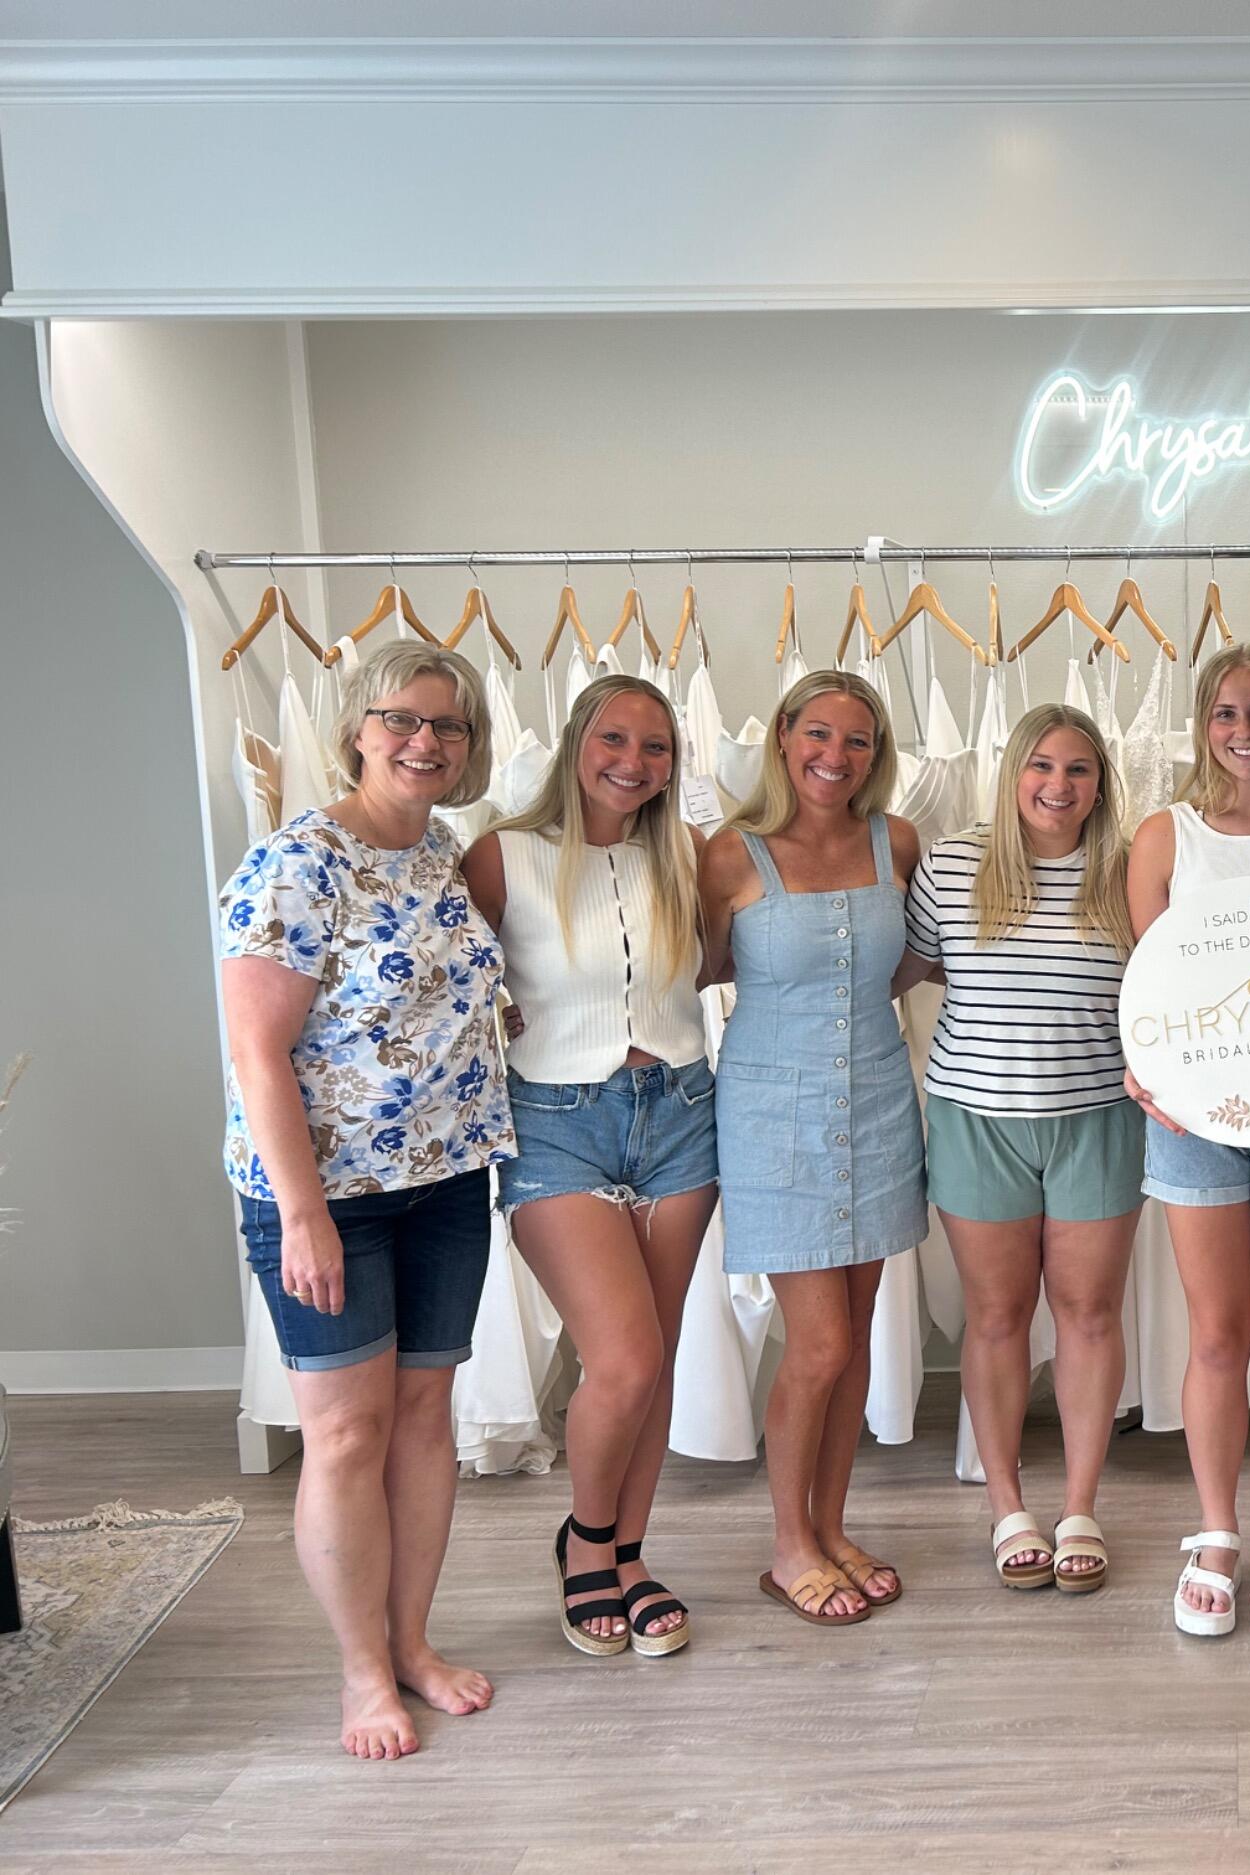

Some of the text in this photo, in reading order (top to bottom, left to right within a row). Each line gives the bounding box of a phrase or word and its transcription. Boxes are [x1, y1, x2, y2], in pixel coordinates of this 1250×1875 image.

[1213, 910, 1248, 927] SAID
[1179, 943, 1200, 957] TO
[1206, 938, 1234, 953] THE
